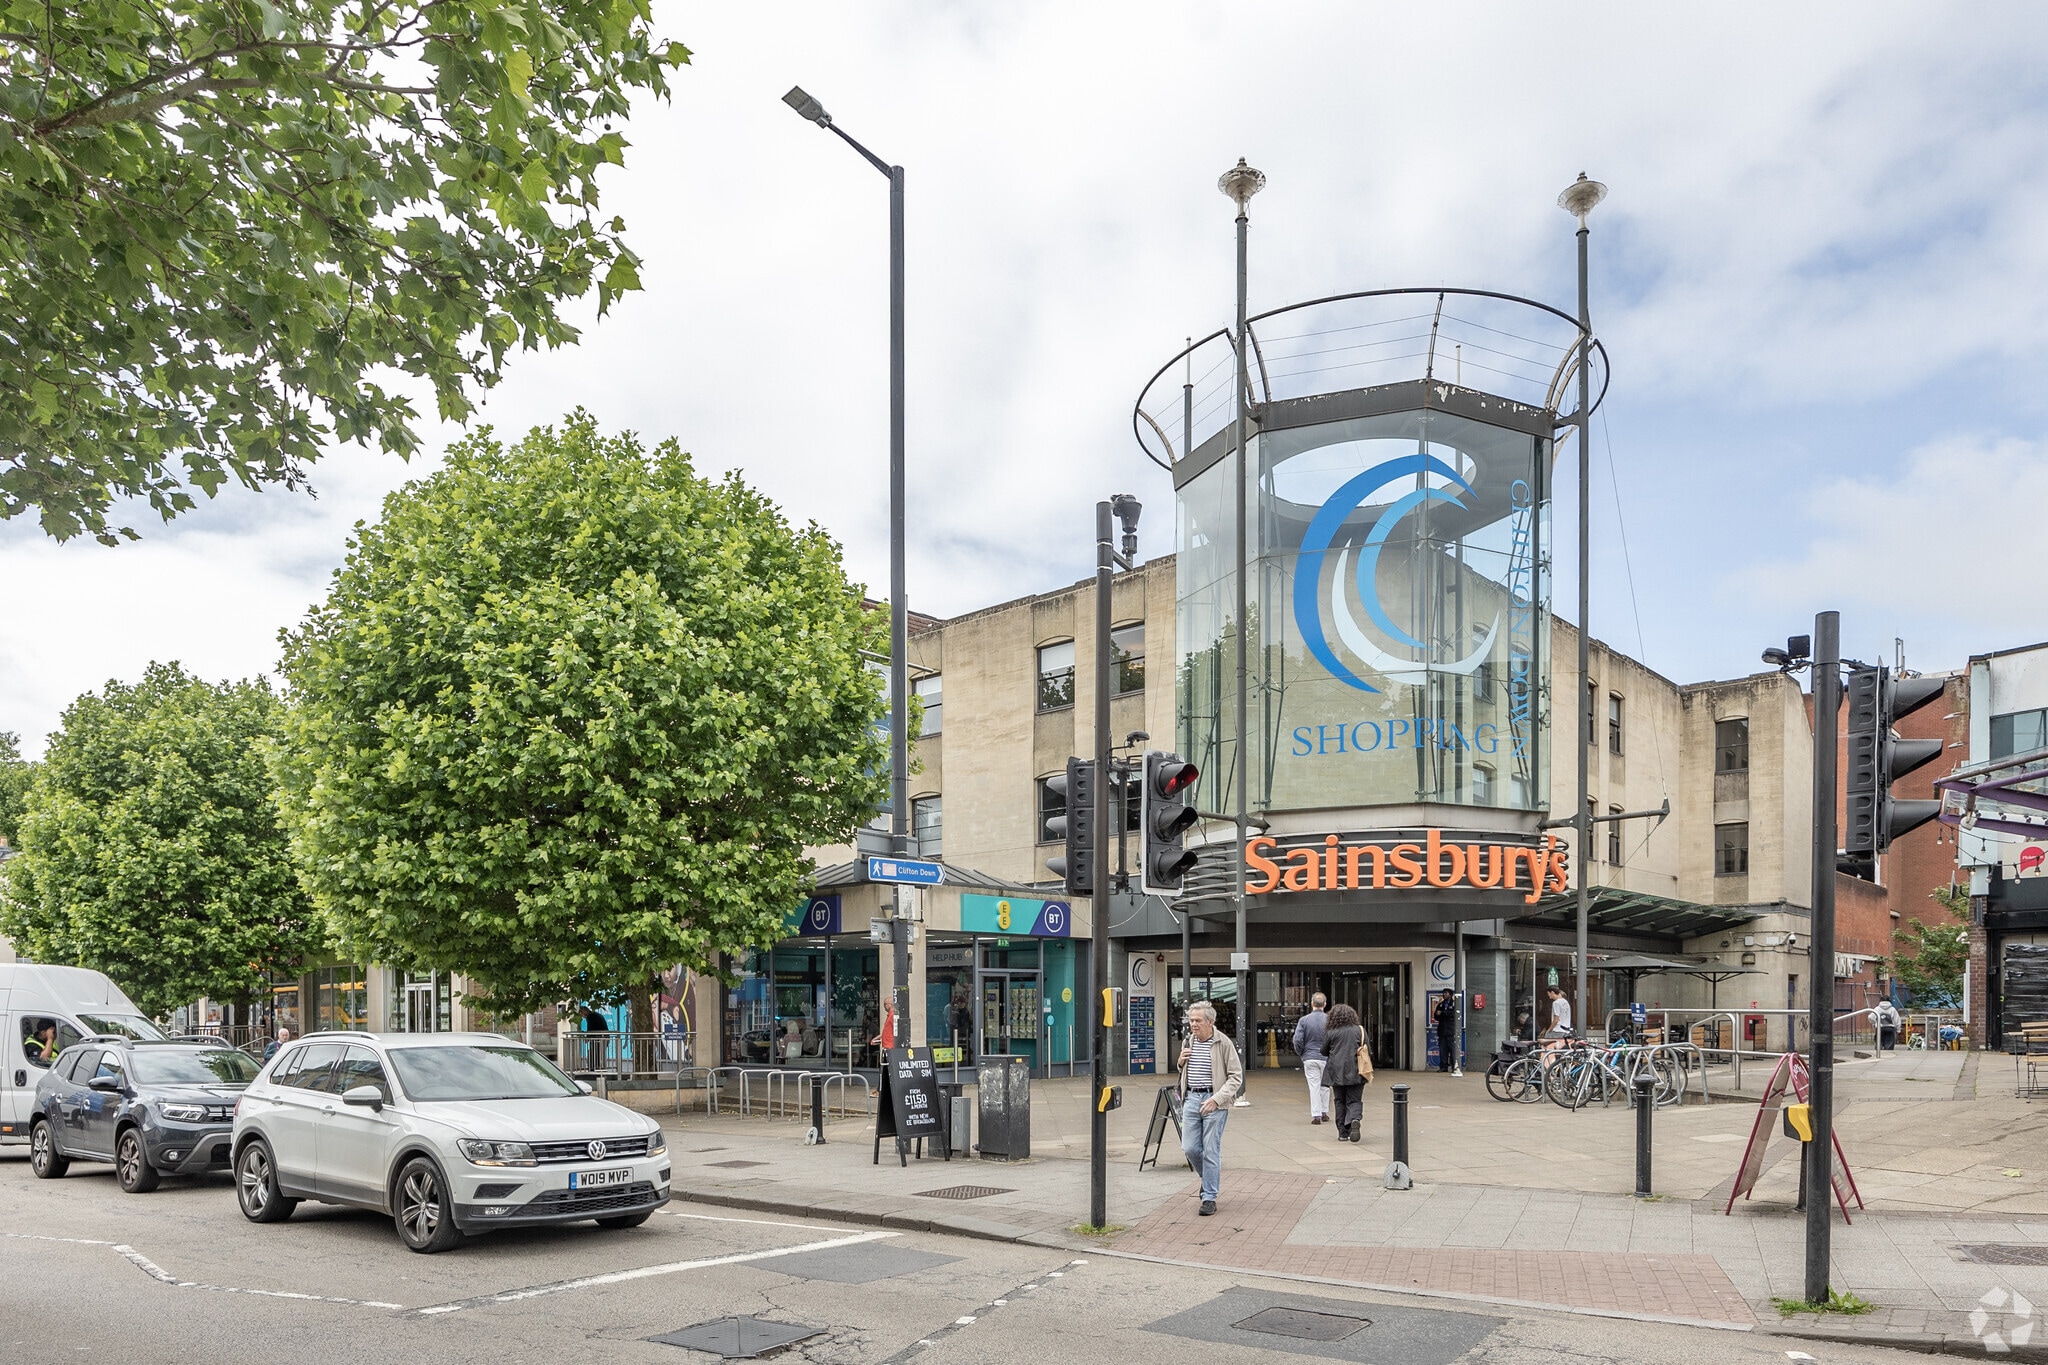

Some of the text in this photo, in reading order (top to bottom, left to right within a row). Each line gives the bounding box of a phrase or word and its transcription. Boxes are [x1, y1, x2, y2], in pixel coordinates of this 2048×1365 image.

[1510, 479, 1530, 759] CLIFTON DOWN
[1292, 717, 1500, 757] SHOPPING
[898, 866, 936, 877] Clifton Down
[1245, 830, 1566, 904] Sainsbury's
[815, 910, 826, 921] BT
[1048, 913, 1060, 924] BT
[932, 953, 963, 962] HELP HUB
[899, 1061, 928, 1069] UNLIMITED
[899, 1069, 931, 1078] DATA SIM
[580, 1172, 606, 1186] WO19
[608, 1170, 629, 1183] MVP
